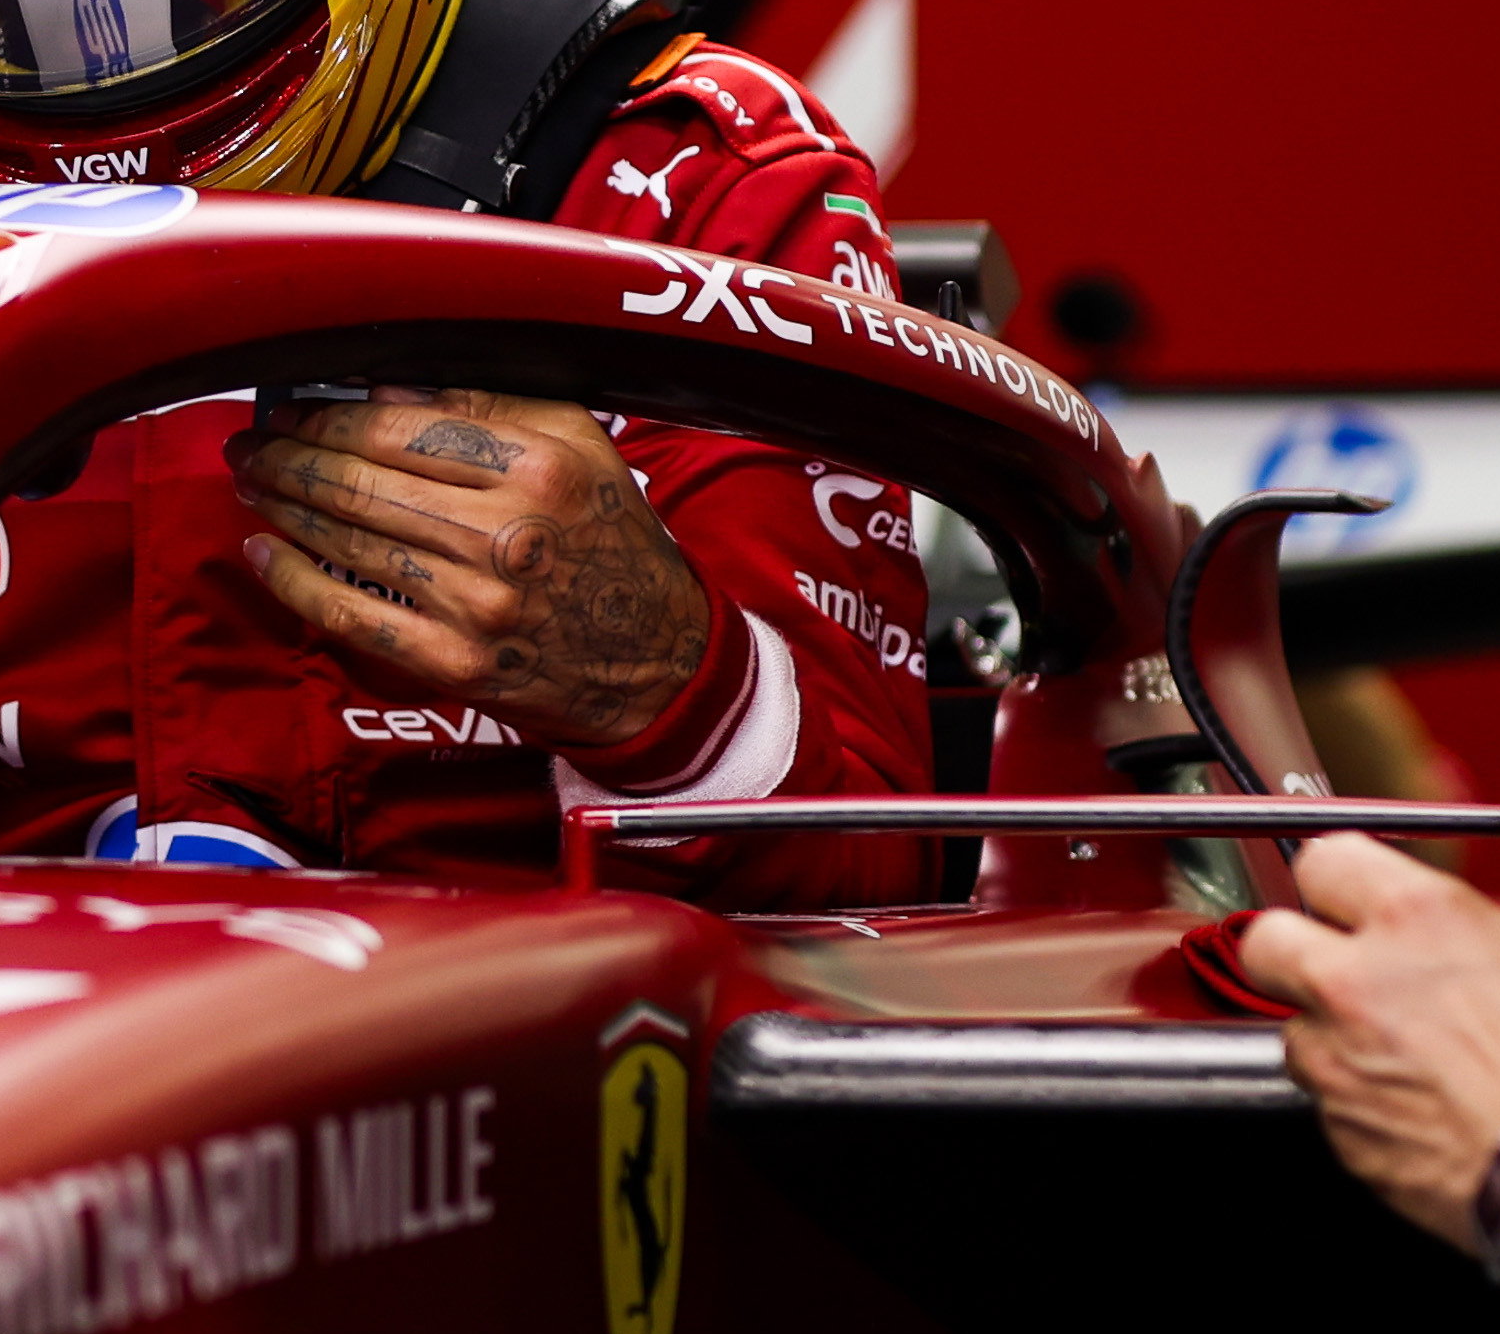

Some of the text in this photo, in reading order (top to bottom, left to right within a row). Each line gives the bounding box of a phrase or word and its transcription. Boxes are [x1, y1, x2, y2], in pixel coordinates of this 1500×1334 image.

[54, 146, 149, 184] VGW
[603, 237, 1100, 453] DXC TECHNOLOGY
[316, 1085, 497, 1261] MILLE
